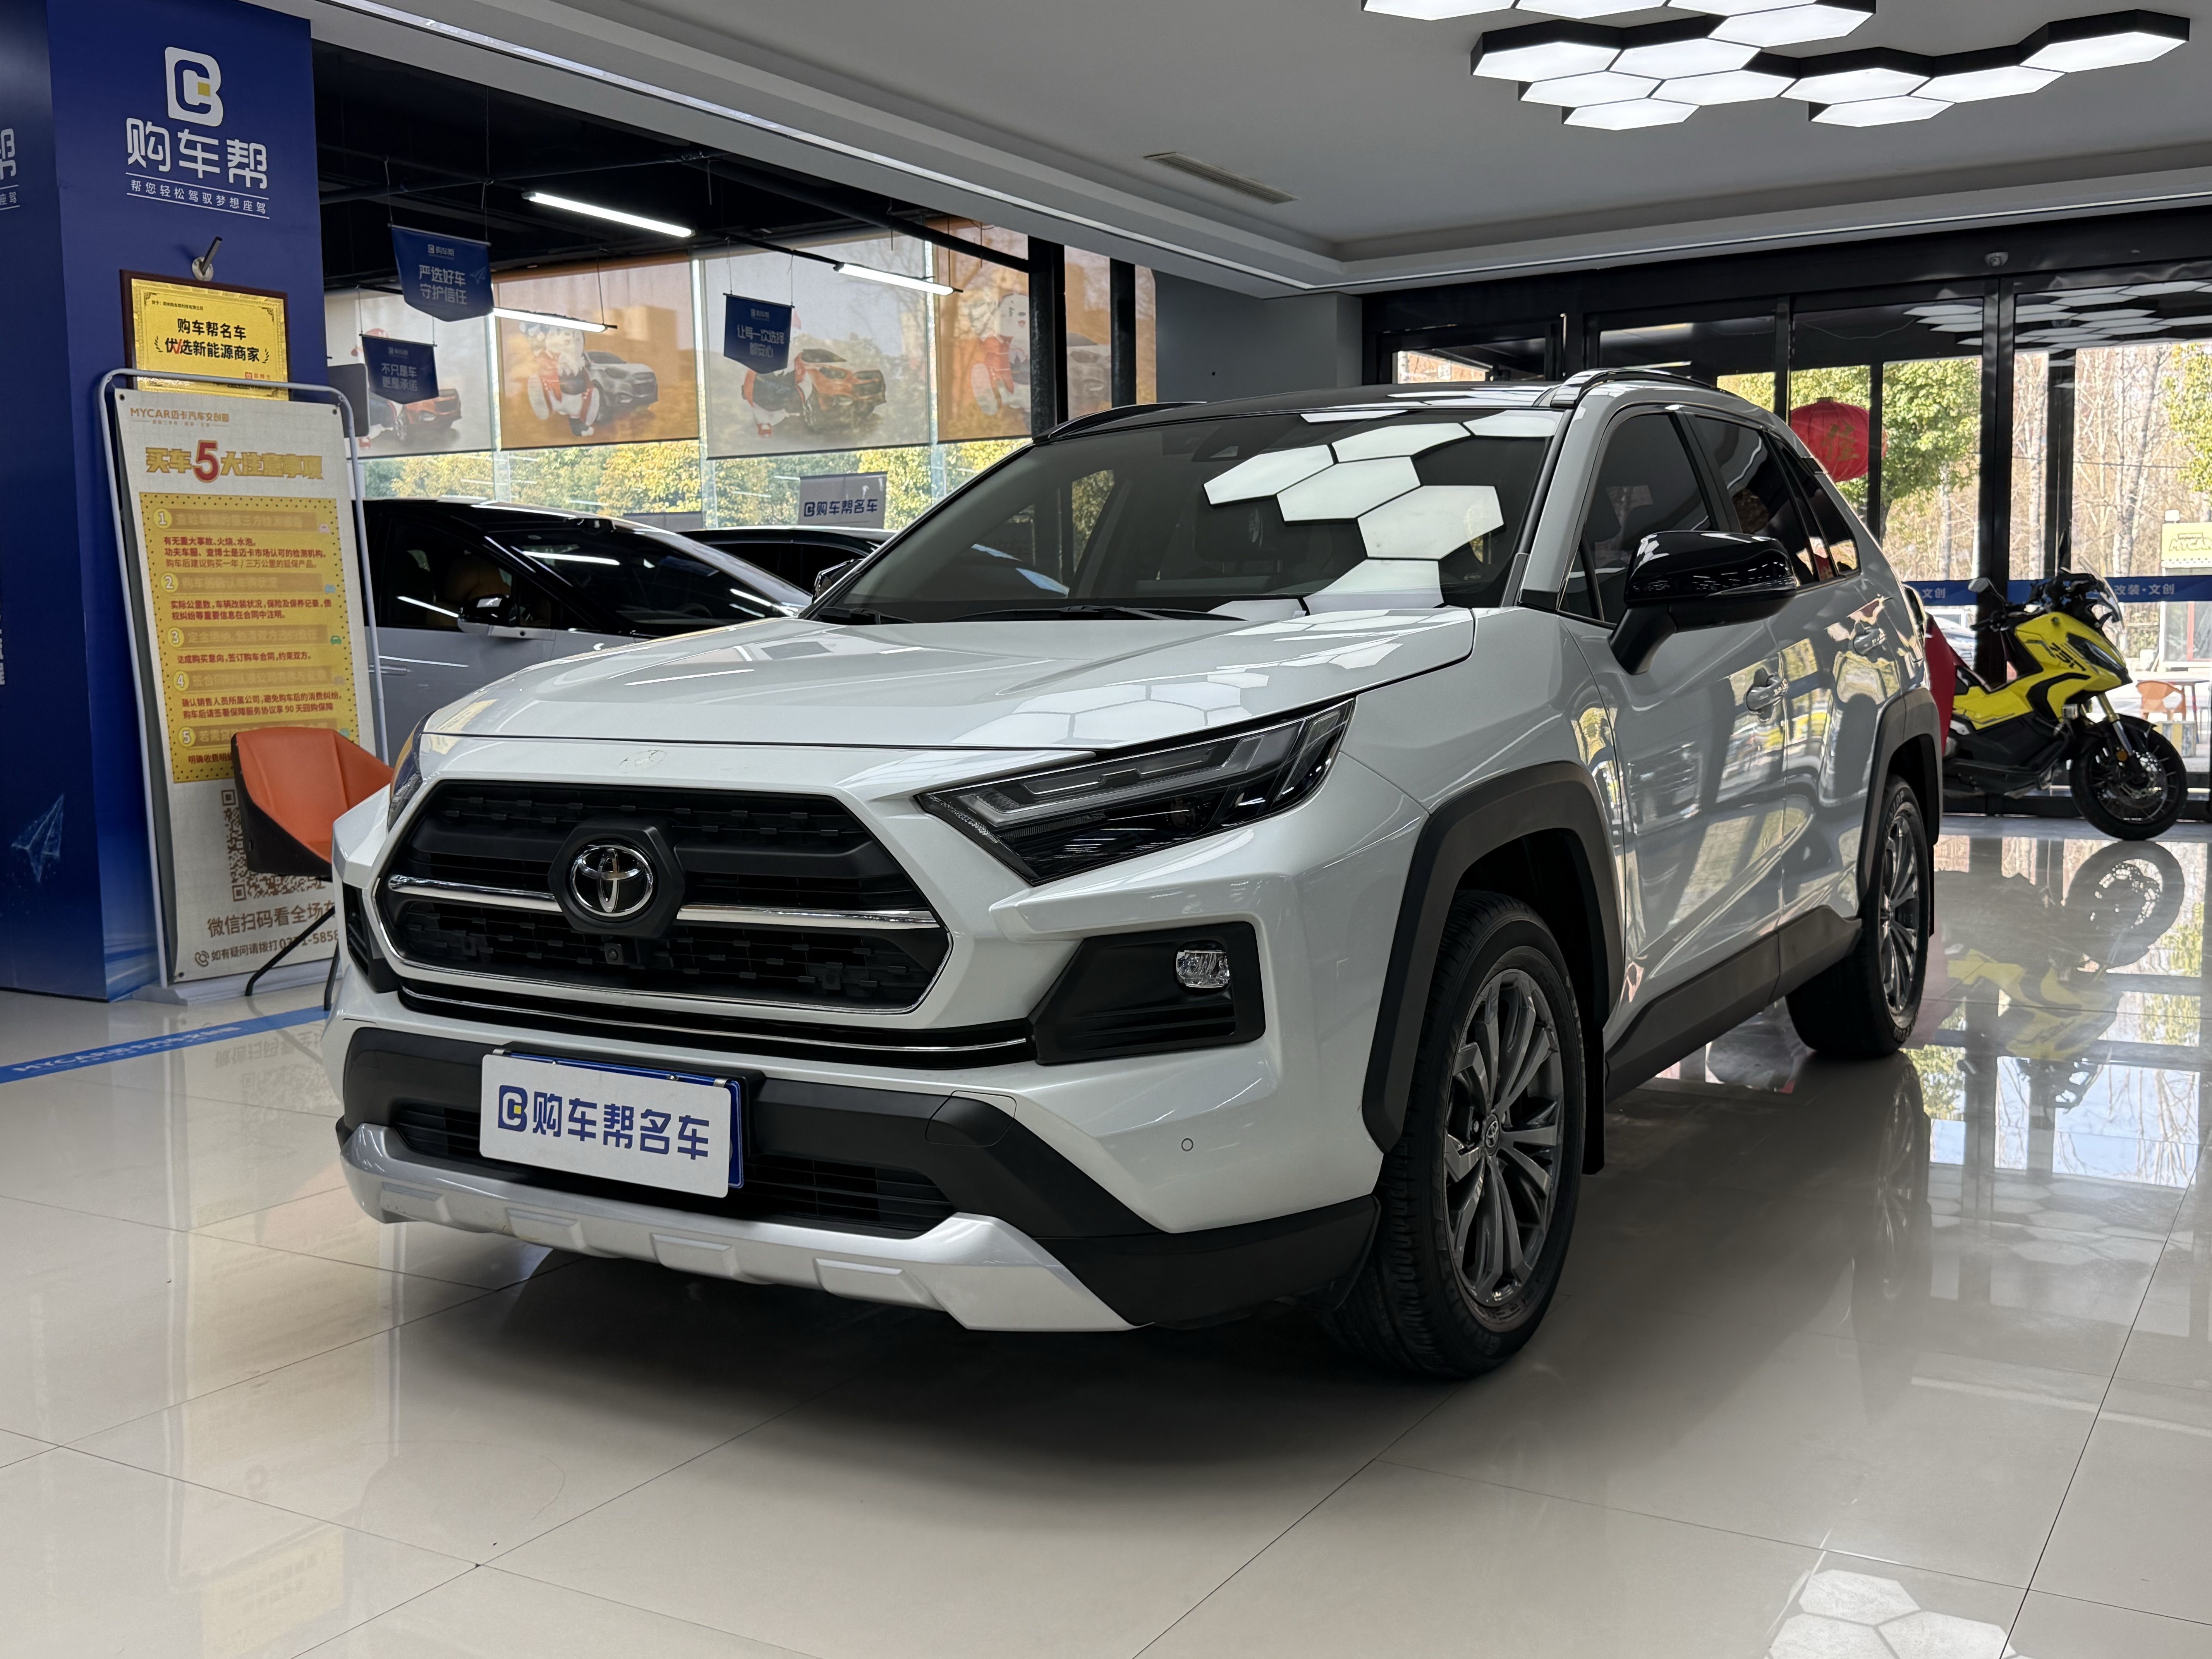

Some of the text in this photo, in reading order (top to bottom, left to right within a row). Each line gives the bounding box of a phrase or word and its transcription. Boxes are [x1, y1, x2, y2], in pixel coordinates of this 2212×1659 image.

[126, 118, 268, 189] 购车帮
[131, 180, 266, 214] 帮您轻松驾驭梦想座驾
[419, 264, 465, 286] 严选好车
[420, 283, 467, 305] 守护信任
[177, 318, 246, 340] 购车帮名车
[737, 325, 785, 345] 让每一次选择
[165, 338, 259, 362] 优选新能源商家
[145, 440, 324, 483] 买车5大注意事项
[816, 499, 878, 515] 购车帮名车
[285, 704, 294, 713] 90
[532, 1092, 709, 1160] 购车帮名车
